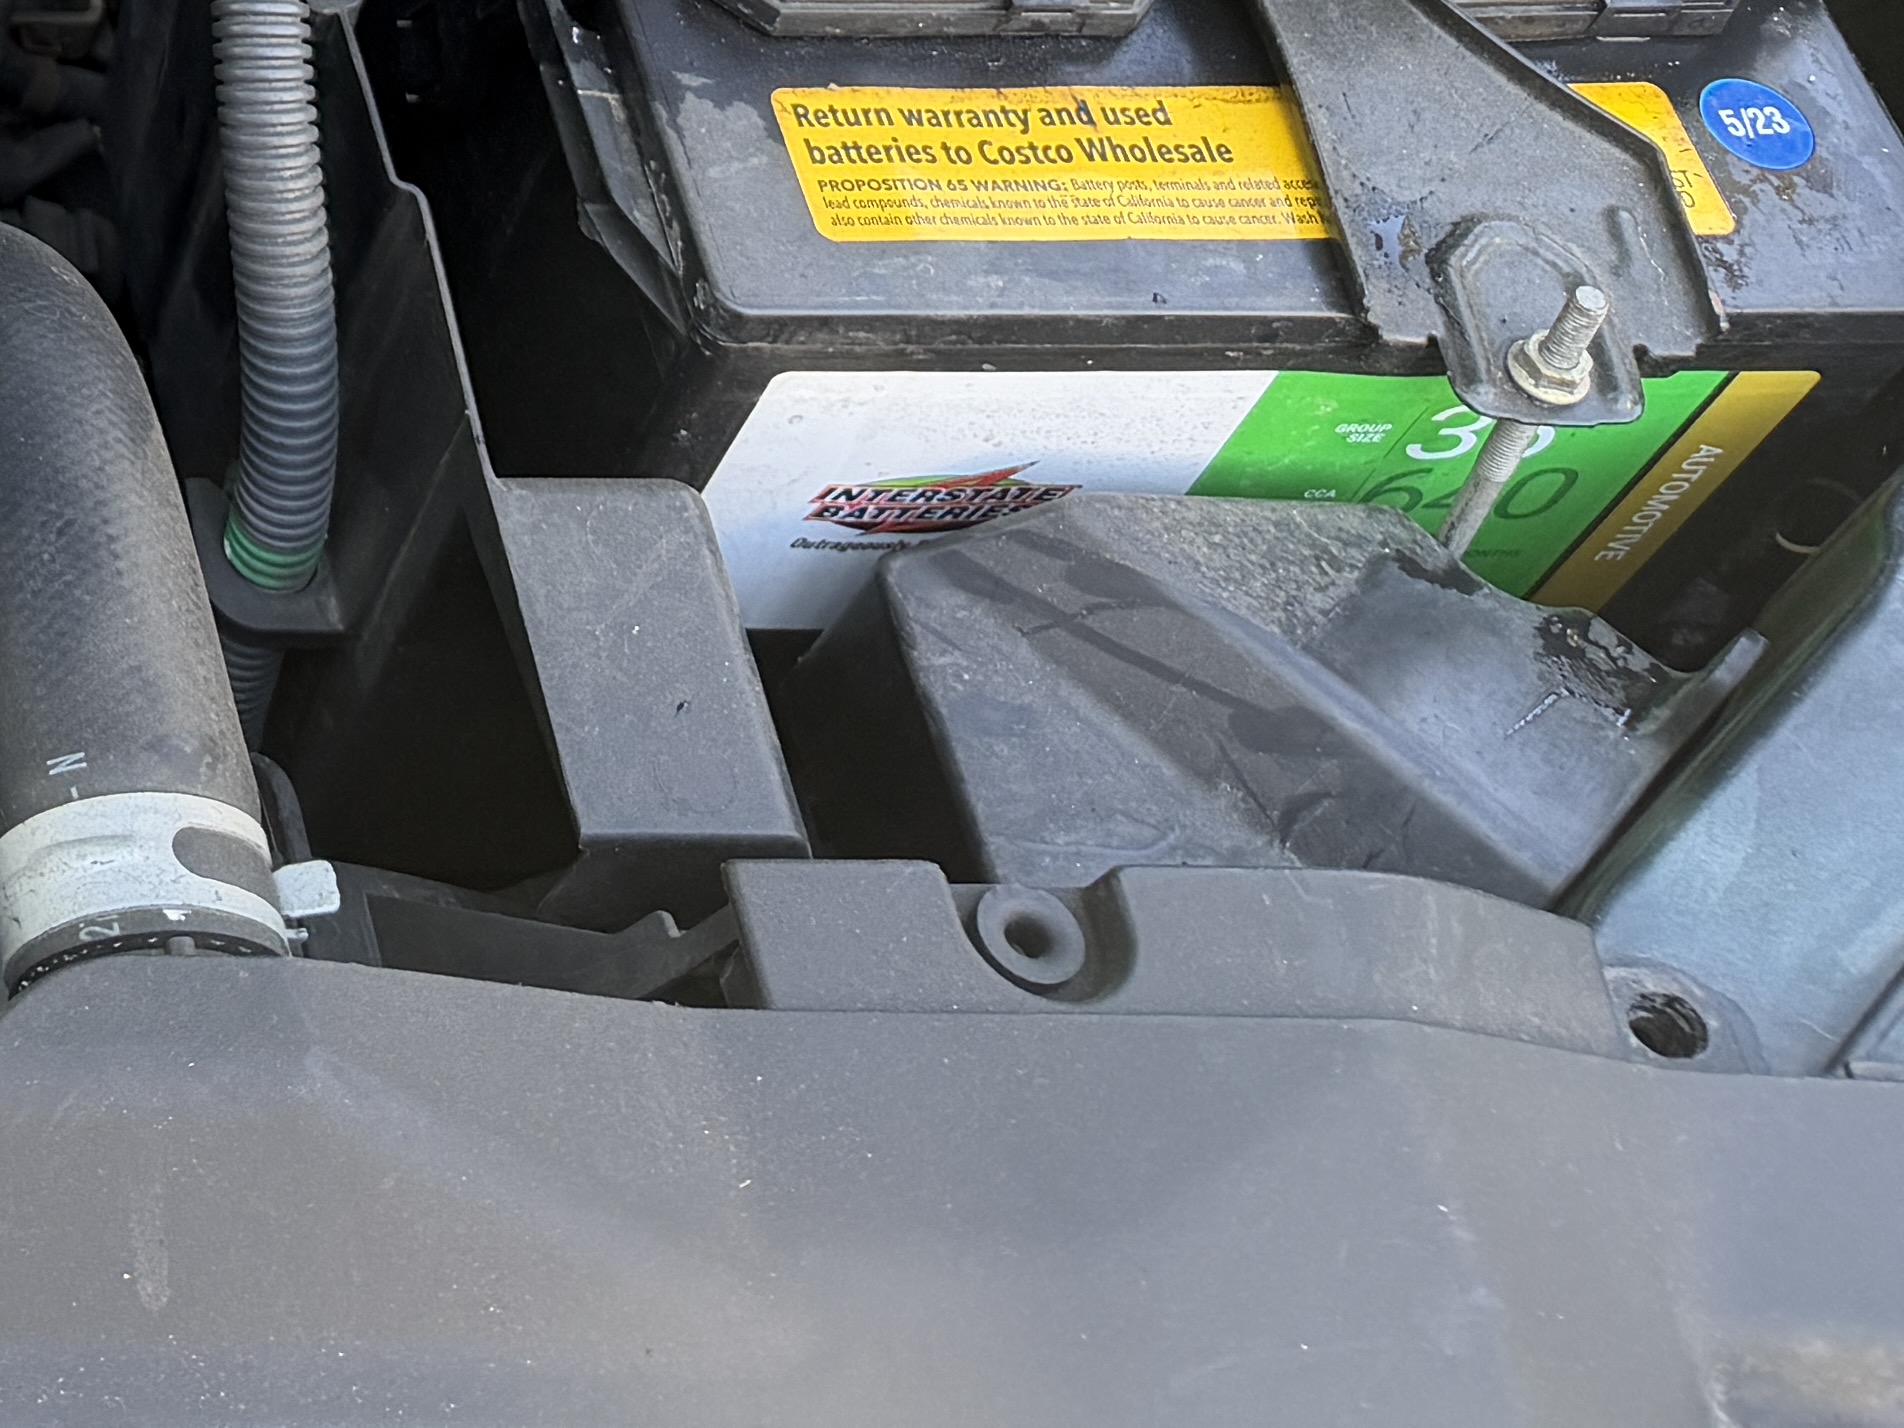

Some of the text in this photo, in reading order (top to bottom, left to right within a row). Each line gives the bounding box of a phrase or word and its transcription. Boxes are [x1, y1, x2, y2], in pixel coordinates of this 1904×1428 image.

[791, 99, 1173, 135] Return warranty and used
[1718, 106, 1791, 138] 5/23
[803, 135, 1235, 165] batteries to Costco Wholesale
[817, 178, 944, 192] PROPOSITION
[946, 179, 968, 191] 65
[970, 178, 1068, 192] WARNING:
[1071, 178, 1114, 196] Battery
[1117, 178, 1151, 193] posts,
[1153, 177, 1210, 191] terminals
[1213, 177, 1235, 191] and
[1238, 177, 1281, 191] related
[824, 197, 849, 209] lead
[853, 197, 928, 211] compounds,
[991, 197, 1031, 209] known
[1033, 198, 1046, 209] to
[1047, 196, 1068, 209] the
[1102, 194, 1115, 208] of
[1117, 194, 1174, 208] California
[1175, 196, 1190, 208] to
[1191, 198, 1225, 208] cause
[1228, 198, 1265, 208] cancer
[1268, 195, 1292, 208] and
[831, 211, 1318, 227] also contain other chemicals known to the state of California to cause cancer. Wash
[1334, 423, 1392, 435] GROUP
[1346, 432, 1386, 444] SIZE
[817, 486, 1072, 503] INTERSTATE
[1303, 488, 1336, 499] CCA
[1594, 444, 1723, 562] AUTOMOTIVE
